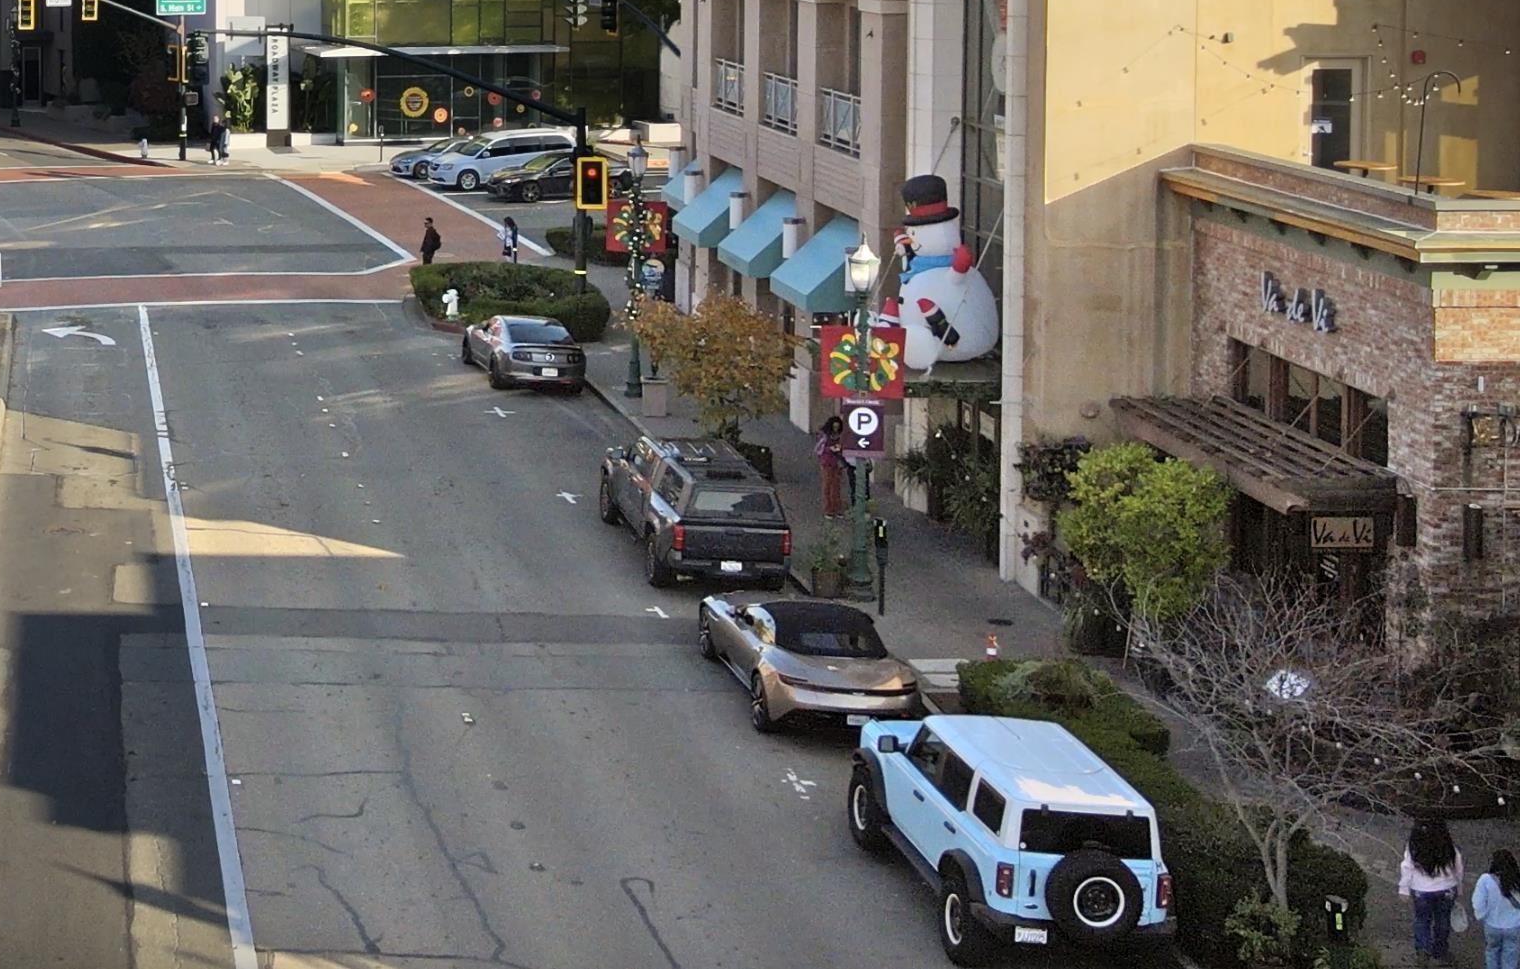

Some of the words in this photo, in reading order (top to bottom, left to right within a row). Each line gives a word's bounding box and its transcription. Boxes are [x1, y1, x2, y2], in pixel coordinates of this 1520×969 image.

[271, 33, 279, 83] ROADWAY
[1260, 271, 1280, 313] Va
[1286, 288, 1304, 323] de
[1311, 288, 1330, 332] Vi
[857, 412, 872, 431] P
[1313, 519, 1335, 545] Va
[1352, 519, 1372, 544] Vi
